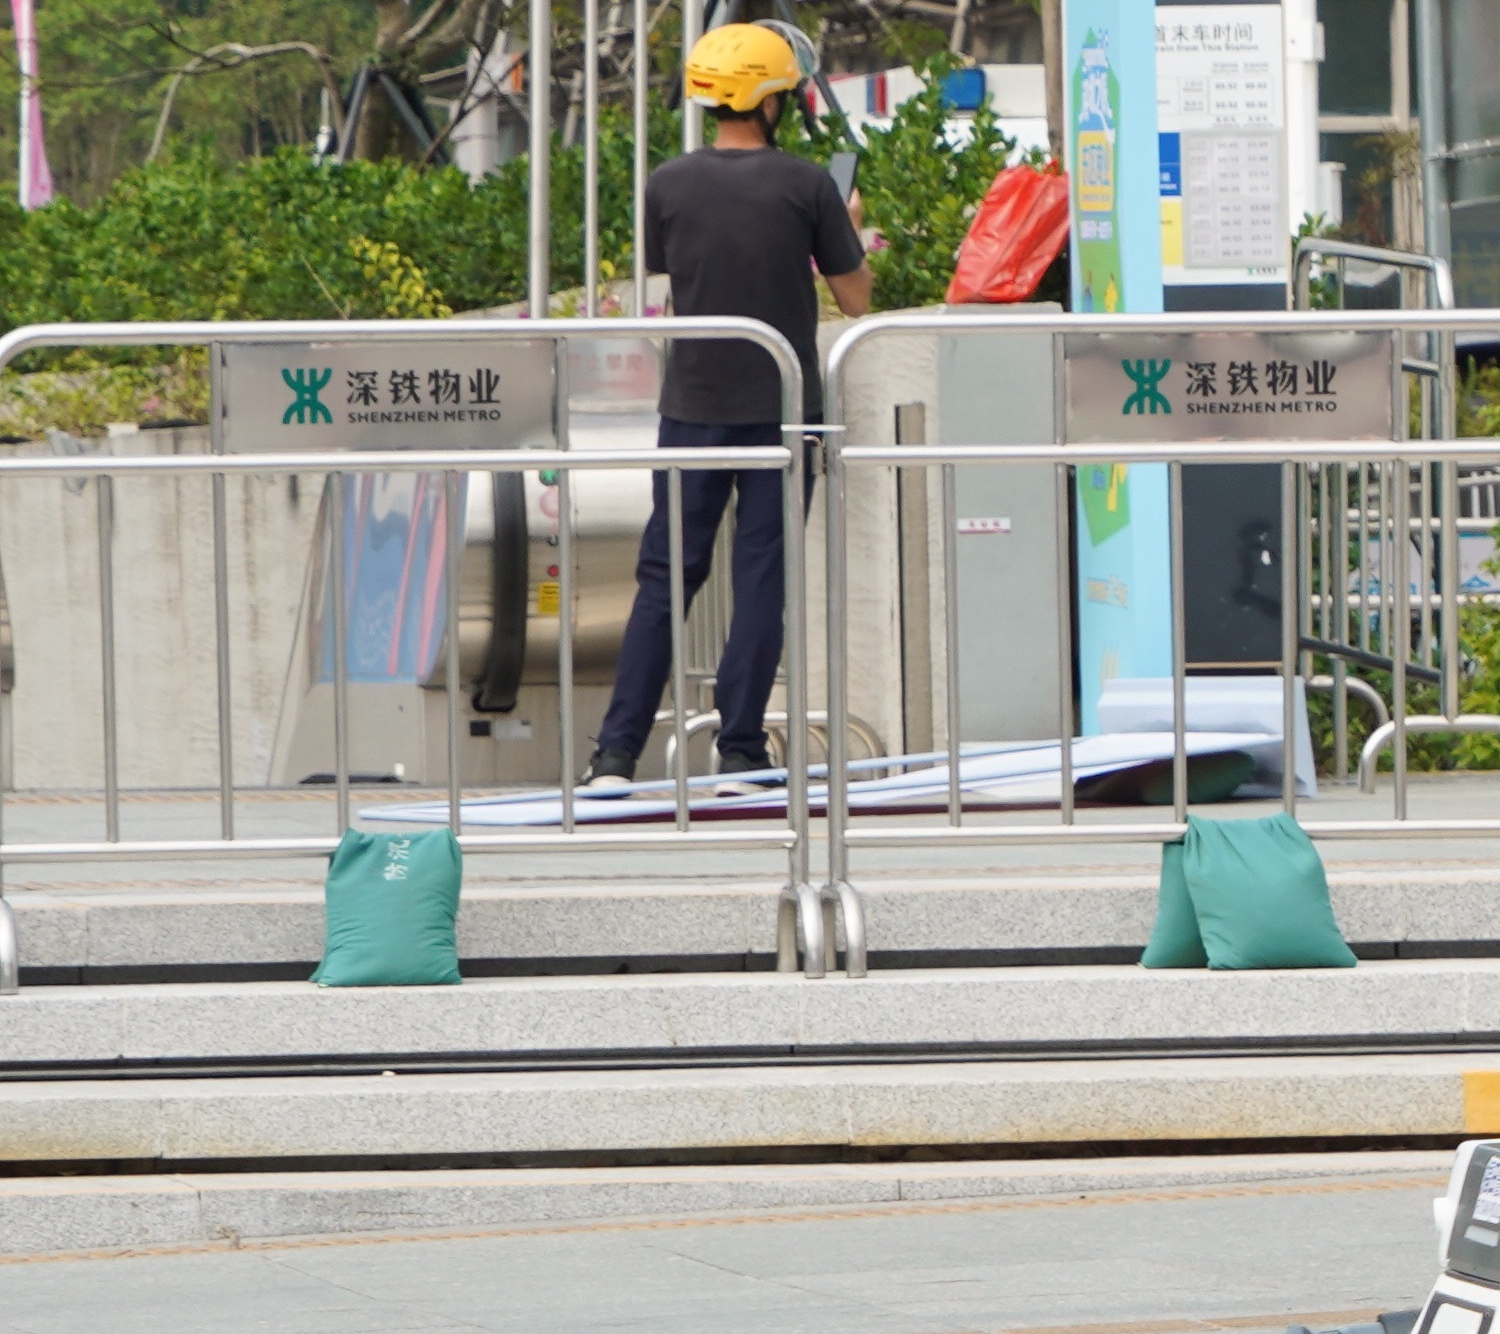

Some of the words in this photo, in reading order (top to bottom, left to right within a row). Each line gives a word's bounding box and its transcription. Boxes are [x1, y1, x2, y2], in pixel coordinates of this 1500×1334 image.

[347, 368, 501, 406] 深铁物业
[1185, 360, 1337, 397] 深铁物业
[348, 410, 439, 424] SHENZHEN
[444, 409, 501, 422] METRO
[1187, 402, 1275, 414] SHENZHEN
[1281, 401, 1337, 413] METRO
